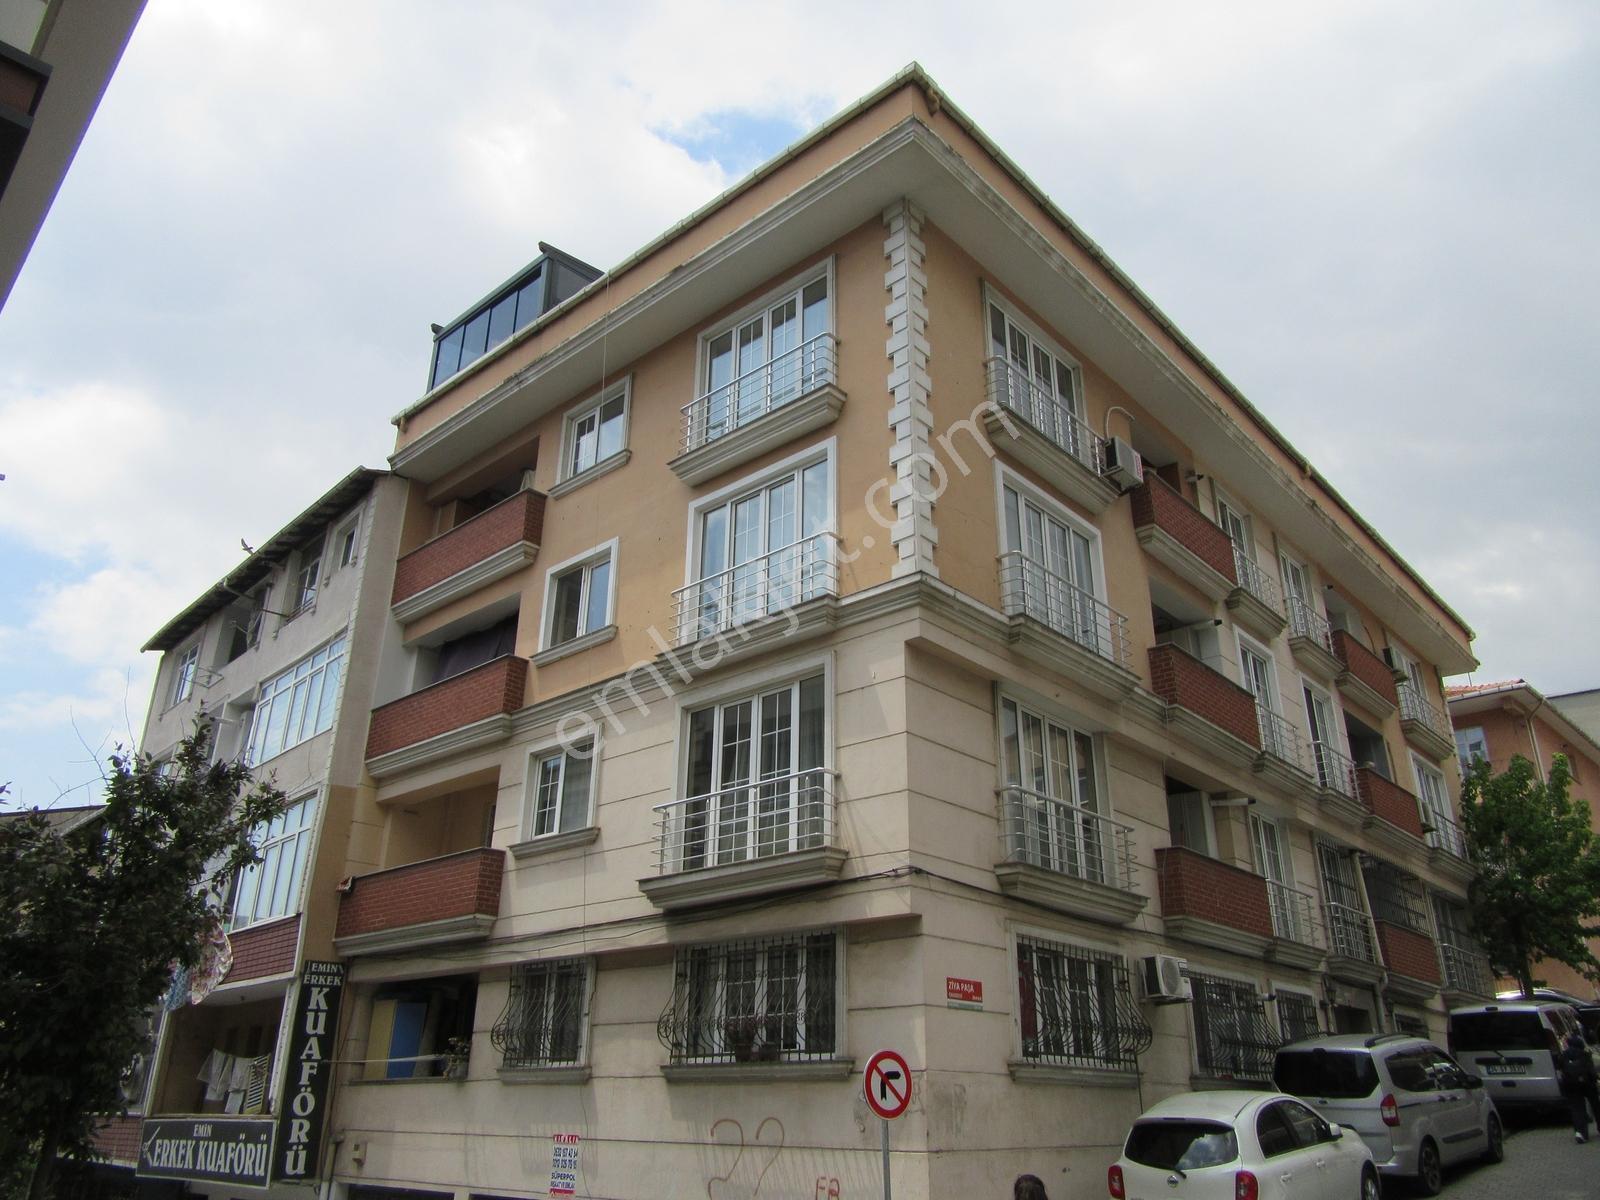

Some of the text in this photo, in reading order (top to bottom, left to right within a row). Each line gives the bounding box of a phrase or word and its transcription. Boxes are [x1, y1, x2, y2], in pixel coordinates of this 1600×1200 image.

[311, 962, 338, 973] EMİN
[303, 974, 342, 986] ERKEK
[285, 987, 330, 1175] KUAFÖRÜ
[193, 1123, 213, 1137] EMİN
[152, 1133, 268, 1176] ERKEK KUAFÖRÜ
